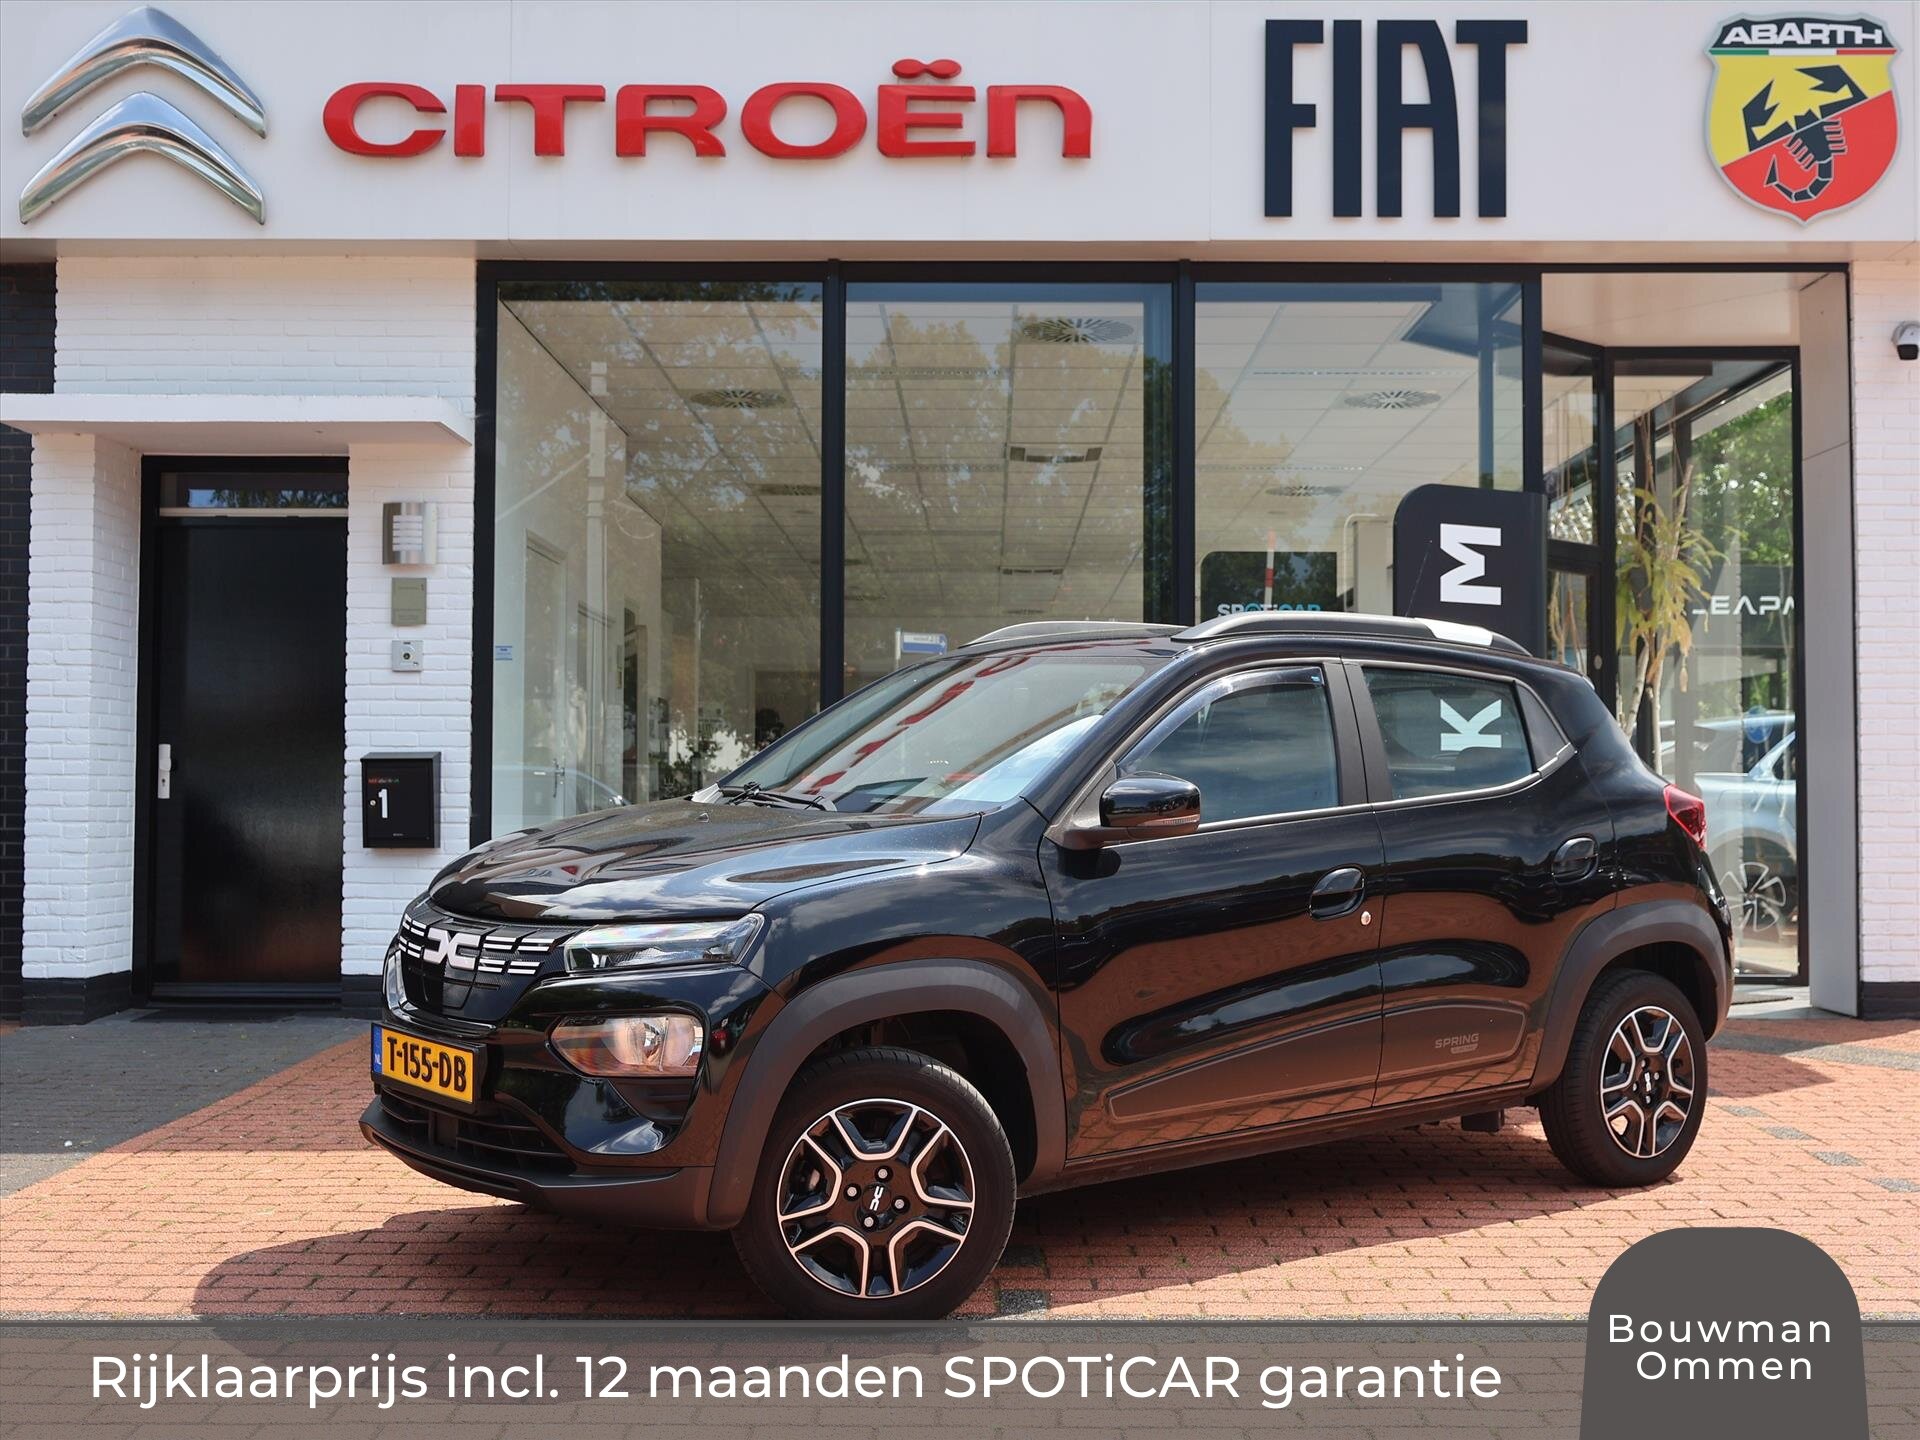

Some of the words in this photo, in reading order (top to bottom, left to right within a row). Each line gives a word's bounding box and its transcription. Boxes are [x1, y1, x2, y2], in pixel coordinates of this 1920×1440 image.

[1722, 22, 1883, 45] ABARTH
[323, 58, 1092, 160] CITROËN
[1264, 19, 1528, 218] FIAT
[378, 788, 389, 819] 1
[1435, 1033, 1480, 1049] SPRING
[387, 1036, 467, 1093] T-155-DB
